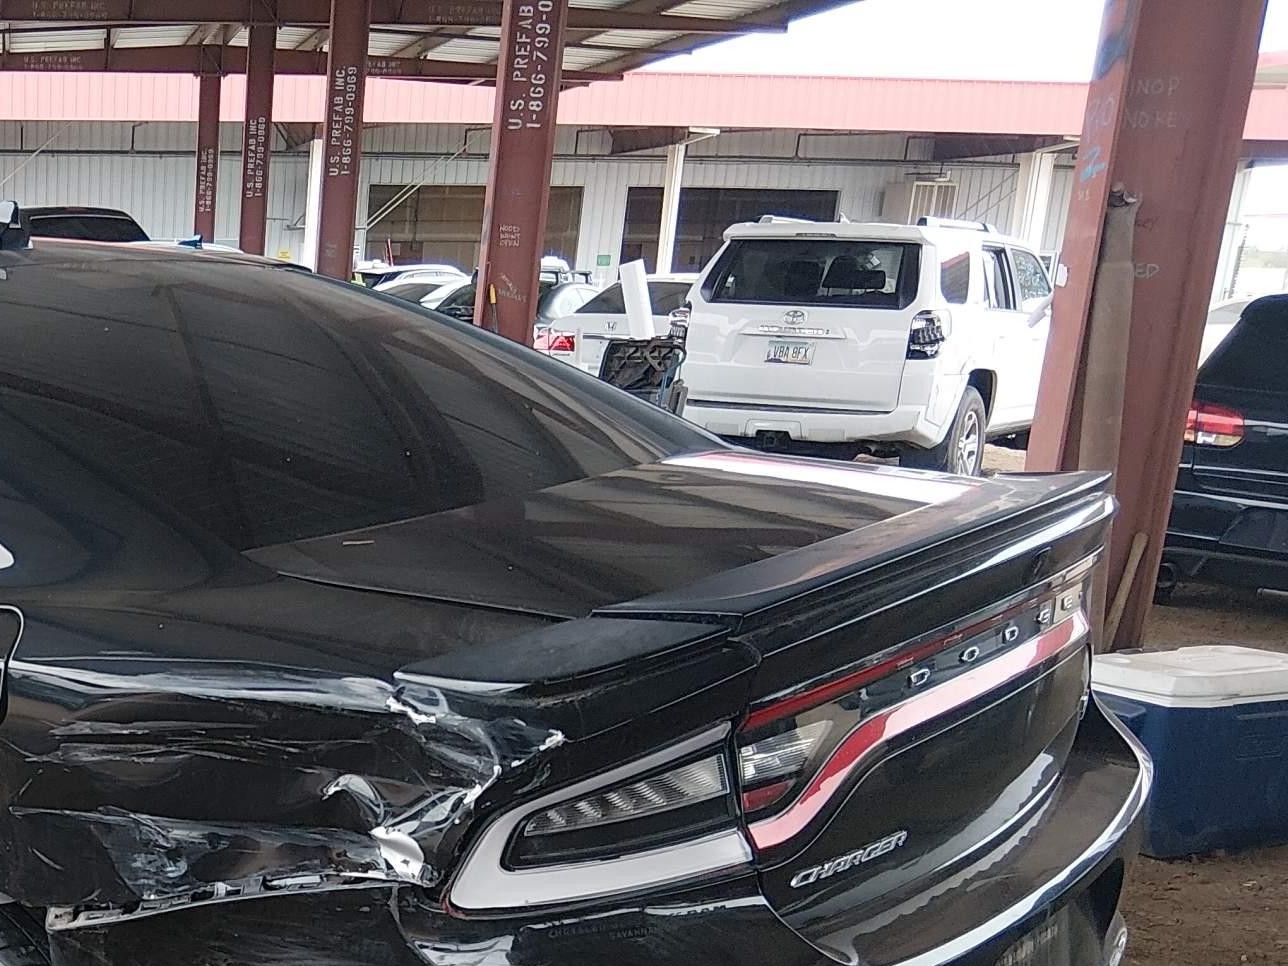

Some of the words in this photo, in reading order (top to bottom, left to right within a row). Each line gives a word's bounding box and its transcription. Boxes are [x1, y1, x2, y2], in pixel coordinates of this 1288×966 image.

[513, 5, 535, 82] PREFAB
[332, 96, 344, 145] PREFAB
[340, 66, 358, 175] 1-866-799-0969
[247, 138, 257, 175] PREFAB
[329, 150, 341, 176] U.S.
[911, 595, 1073, 686] DODGE
[790, 828, 908, 889] CHARGER
